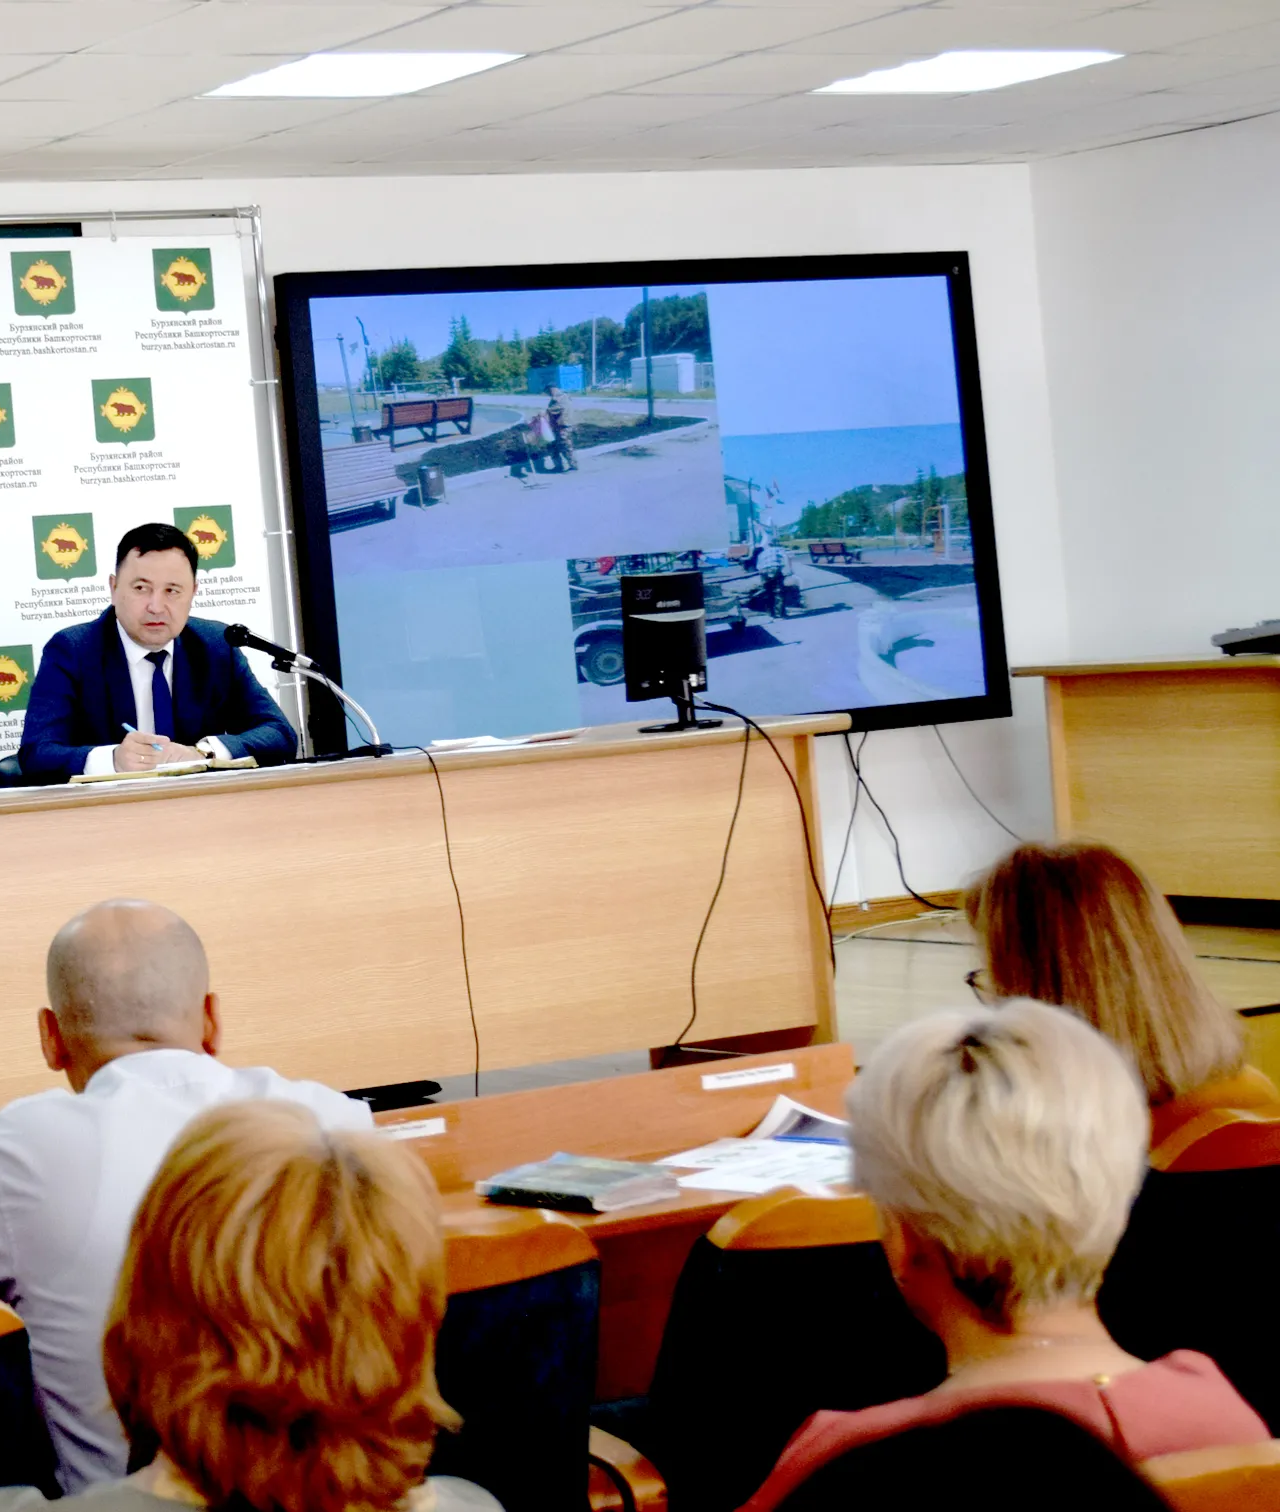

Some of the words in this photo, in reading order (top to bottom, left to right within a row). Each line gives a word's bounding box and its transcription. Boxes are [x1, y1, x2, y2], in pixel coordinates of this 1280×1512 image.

[9, 322, 58, 334] Бурзянский
[58, 322, 84, 332] район
[150, 318, 197, 329] Бурзянский
[198, 317, 222, 328] район
[43, 333, 102, 344] Башкортостан
[134, 329, 182, 341] Республики
[184, 329, 240, 339] Башкортостан
[140, 340, 236, 352] burzyan.bashkortostan.ru
[90, 451, 136, 462] Бурзянский
[138, 450, 163, 460] район
[73, 463, 122, 474] Республики
[123, 461, 180, 472] Башкортостан
[79, 473, 176, 486] burzyan.bashkortostan.ru
[219, 574, 243, 585] район
[30, 585, 78, 598] Бурзянский
[80, 584, 106, 595] район
[204, 586, 260, 596] Башкортостан
[14, 598, 64, 610] Республики
[65, 596, 112, 607] Башкортос
[191, 597, 257, 609] .bashkortostan.ru
